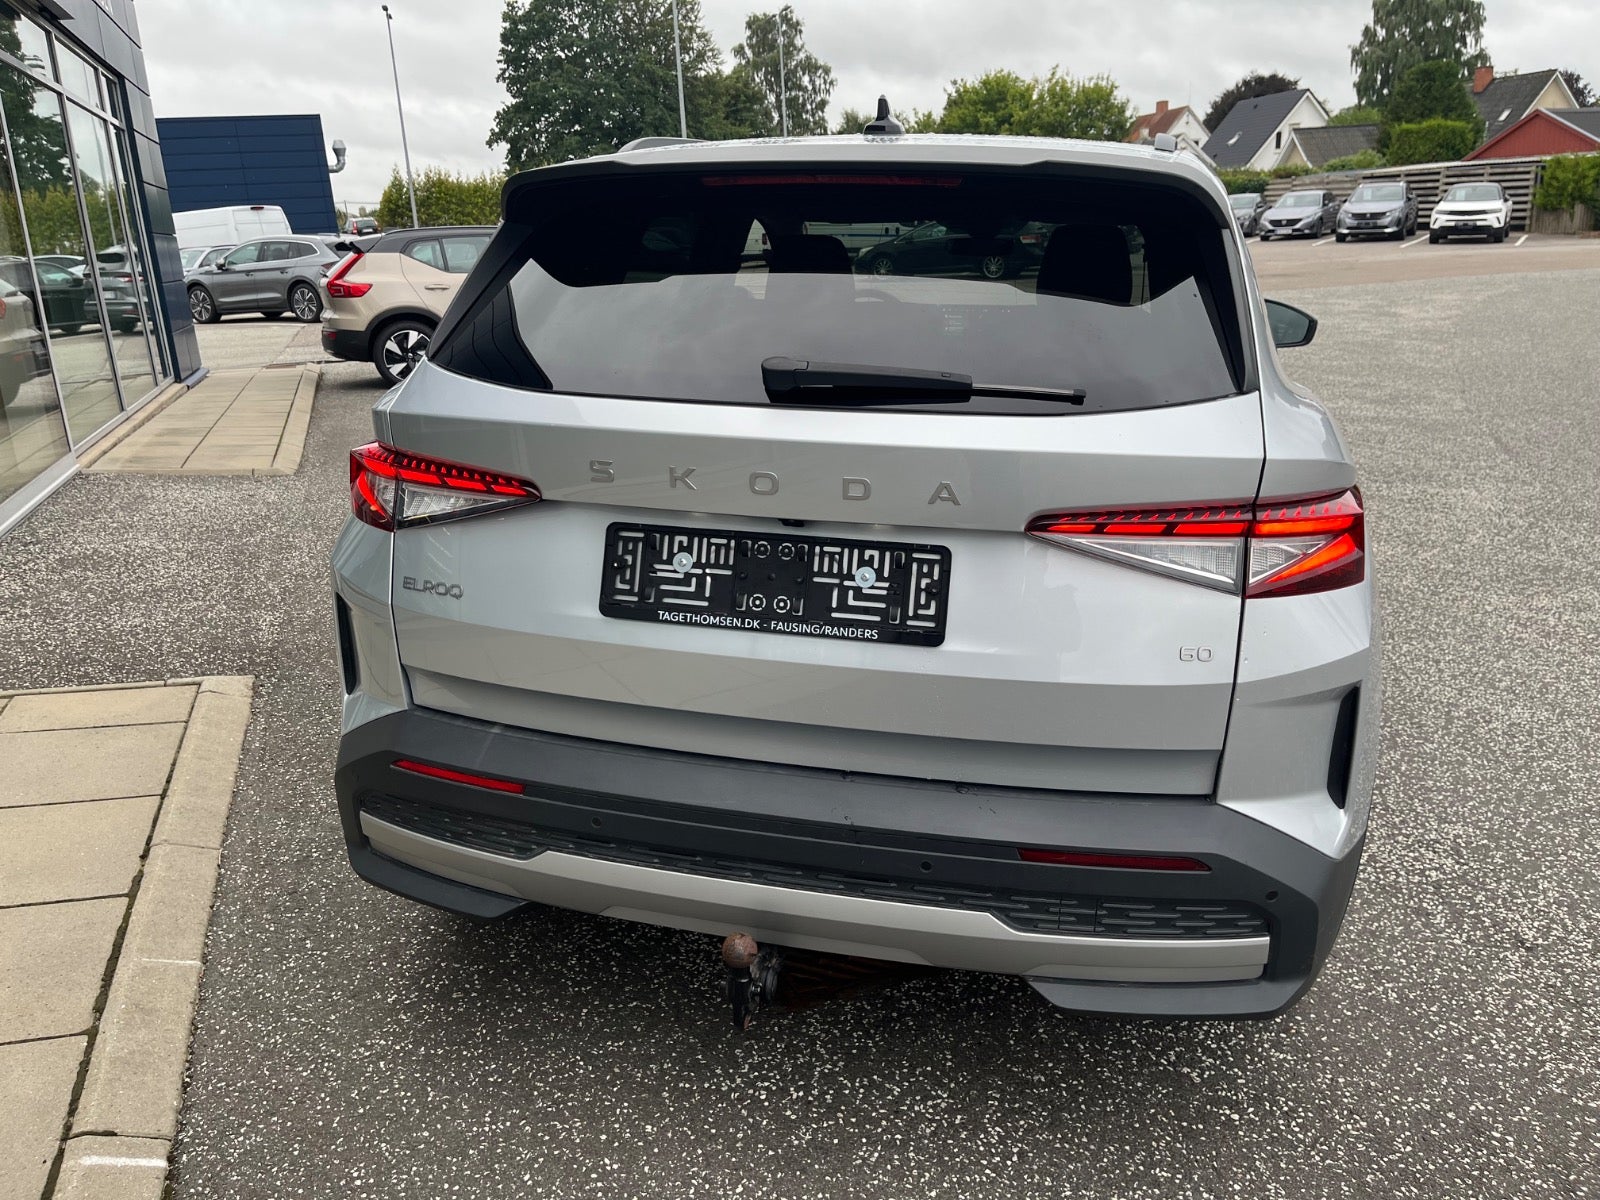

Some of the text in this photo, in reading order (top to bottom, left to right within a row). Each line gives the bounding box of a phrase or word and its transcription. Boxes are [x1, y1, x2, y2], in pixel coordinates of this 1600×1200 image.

[589, 459, 962, 506] SKODA
[402, 576, 464, 600] ELROQ
[657, 610, 761, 629] TAGETHOMSEN.DK
[770, 620, 879, 640] FAUSING/RANDERS
[1179, 646, 1213, 662] 60
